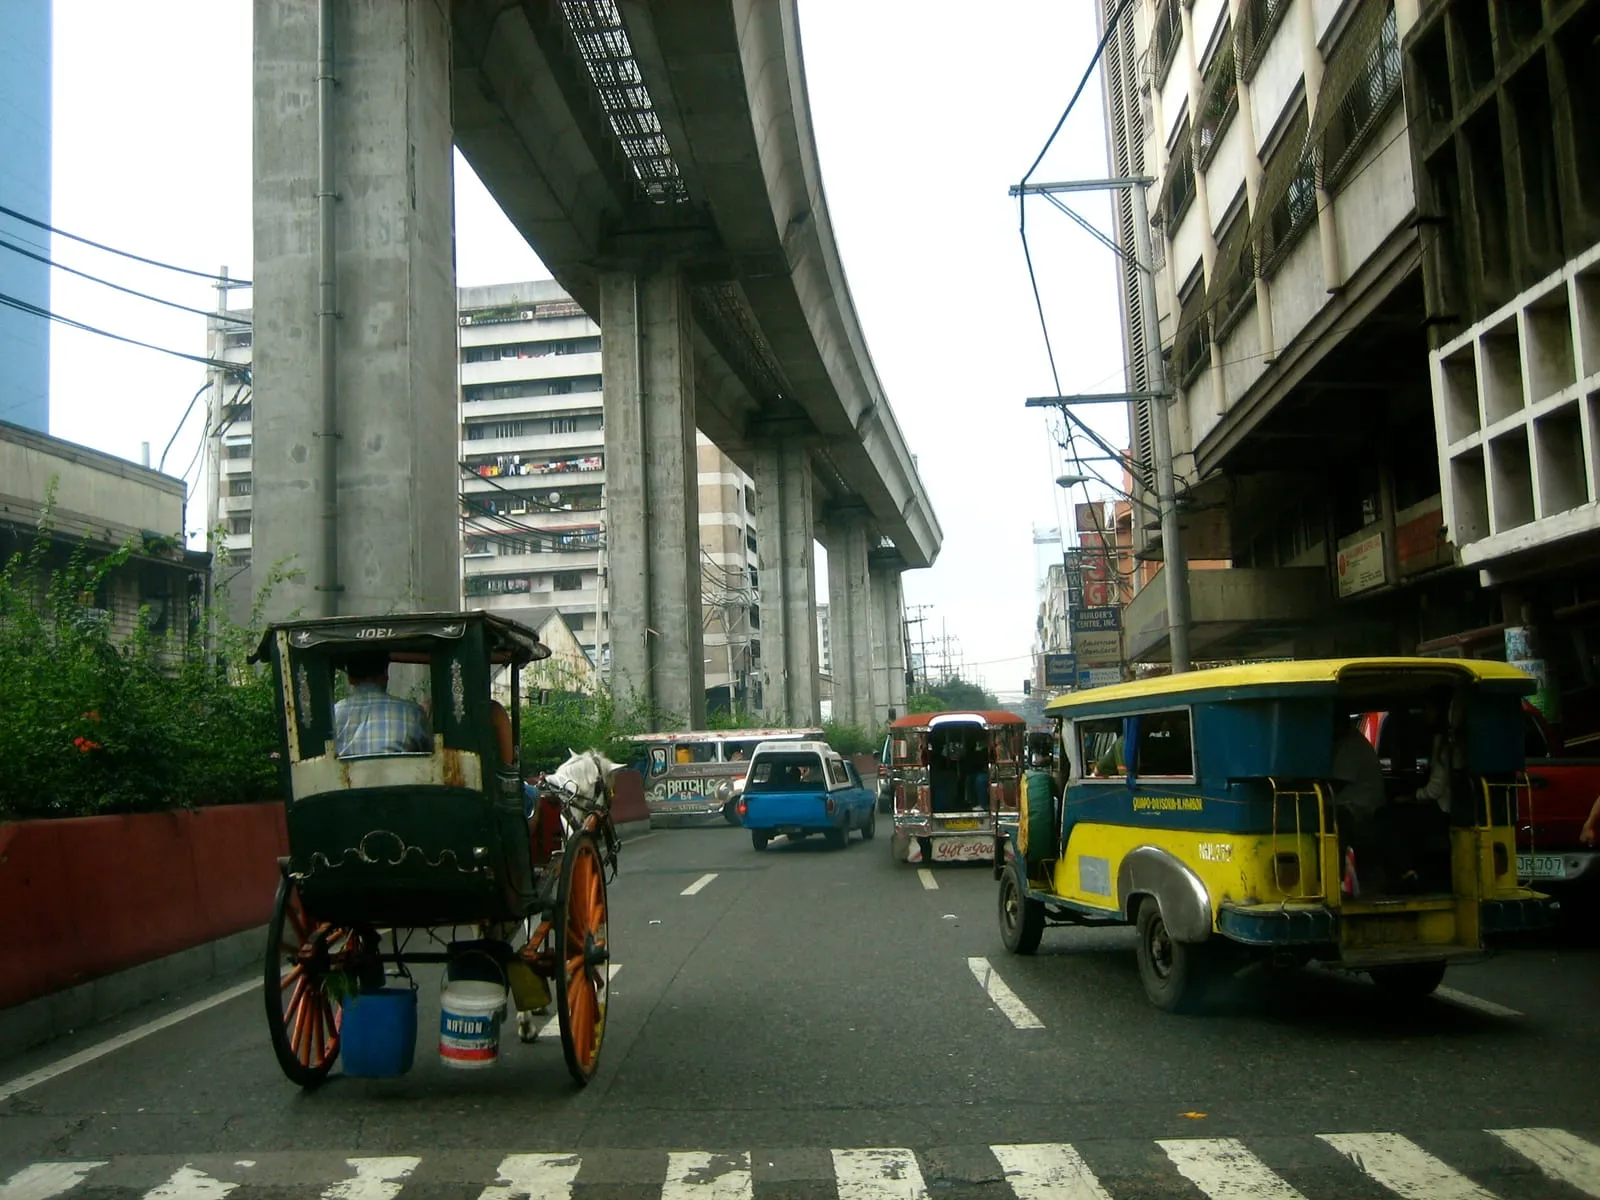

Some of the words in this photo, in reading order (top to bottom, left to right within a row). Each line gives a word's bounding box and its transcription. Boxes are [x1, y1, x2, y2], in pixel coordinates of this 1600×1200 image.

[355, 628, 397, 638] JOEL
[667, 778, 704, 799] BATCH
[447, 1019, 482, 1034] NATION
